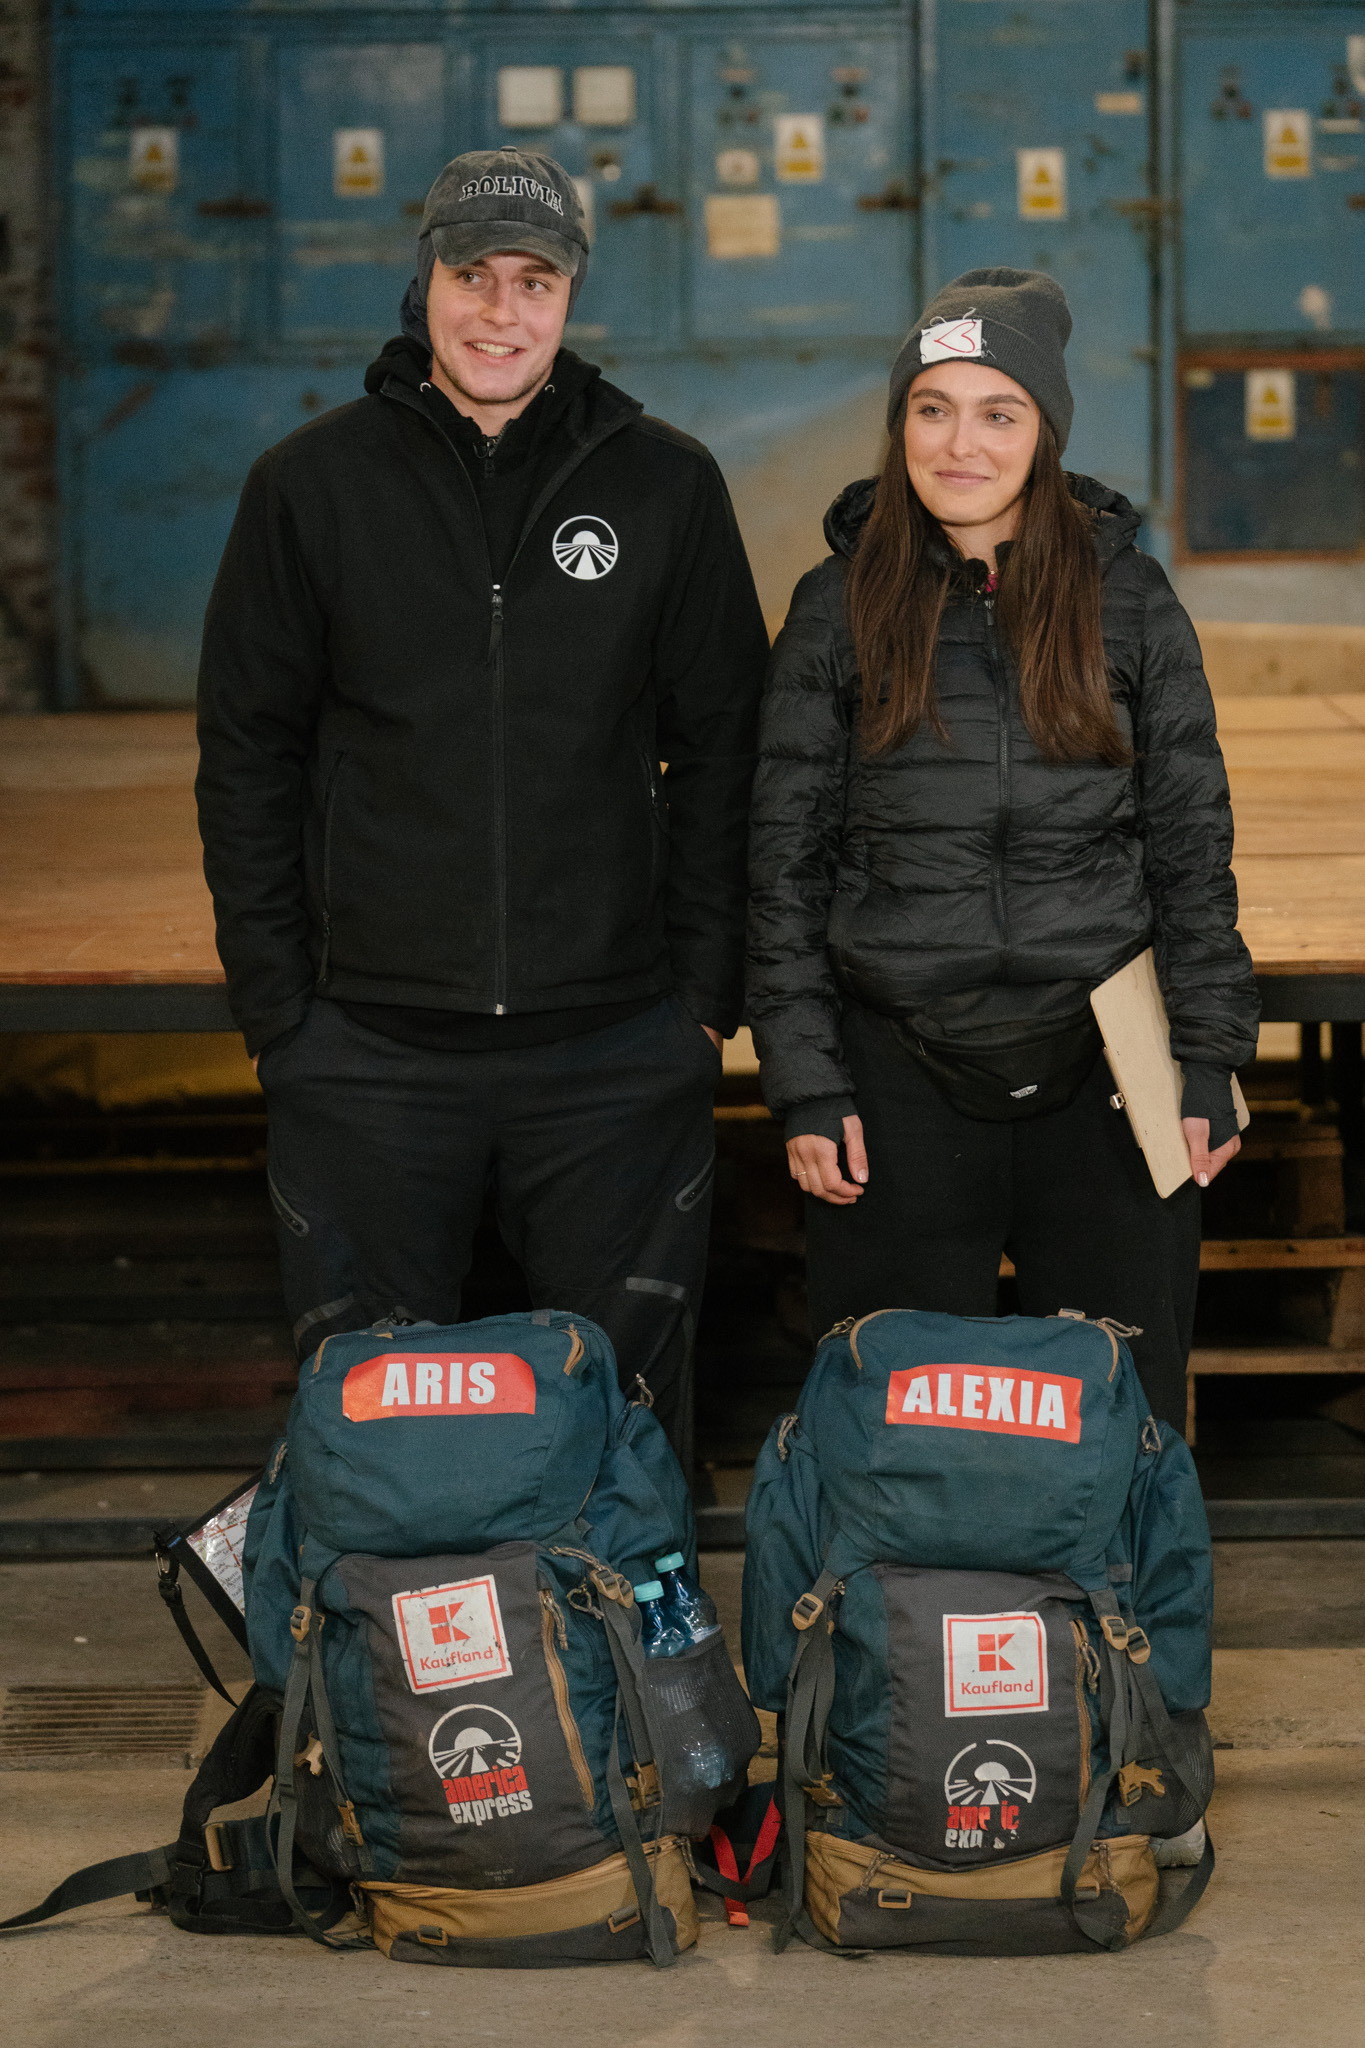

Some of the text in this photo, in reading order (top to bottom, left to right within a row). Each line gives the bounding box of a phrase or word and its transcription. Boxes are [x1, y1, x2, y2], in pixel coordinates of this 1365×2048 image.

[459, 176, 563, 216] BOLIVIA
[381, 1362, 496, 1406] ARIS
[902, 1373, 1066, 1429] ALEXIA
[420, 1645, 494, 1671] Kaufland
[961, 1679, 1034, 1695] Kaufland
[442, 1764, 528, 1804] america
[448, 1789, 533, 1826] express
[947, 1800, 1020, 1831] ameic
